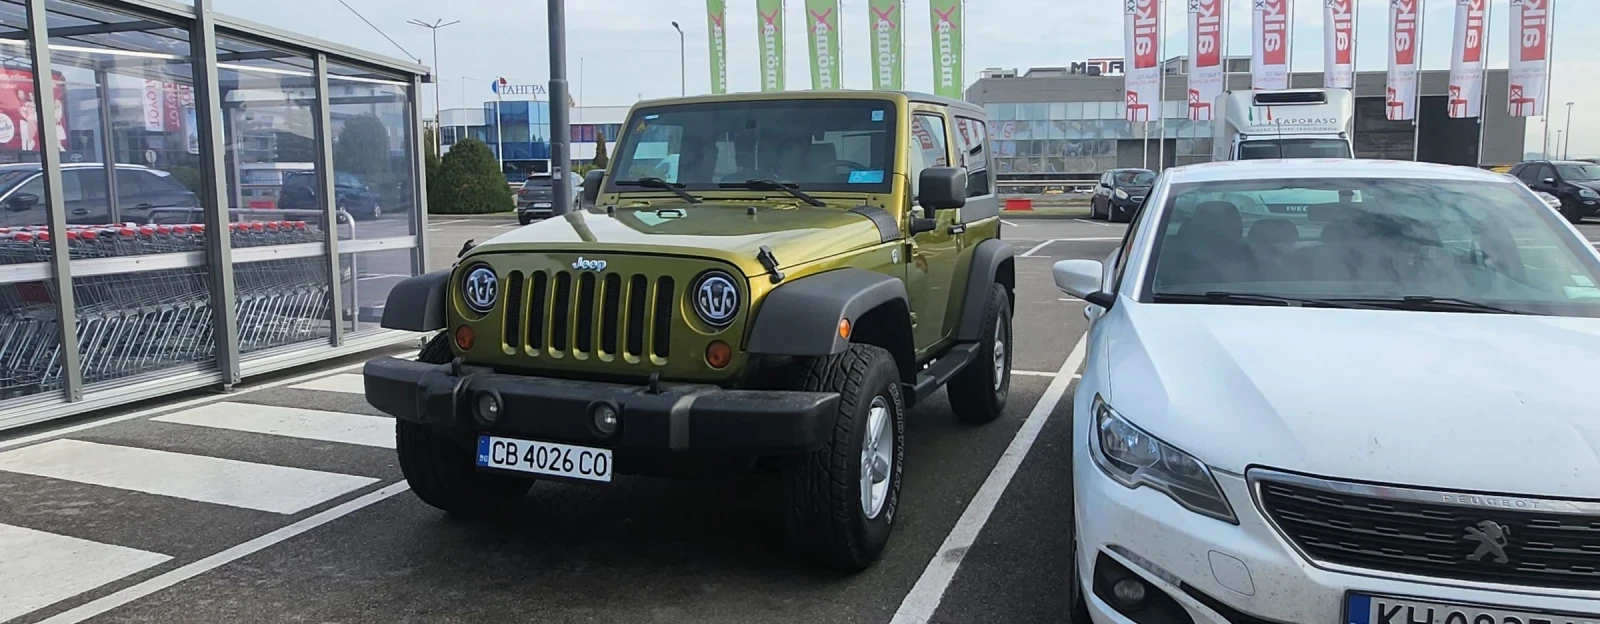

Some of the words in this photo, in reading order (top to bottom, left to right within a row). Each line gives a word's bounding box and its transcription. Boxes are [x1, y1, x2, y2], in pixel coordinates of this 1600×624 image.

[500, 84, 546, 95] ТАНГРА
[1275, 117, 1337, 125] CAPORASO
[571, 256, 607, 272] Jeep
[492, 441, 518, 466] CB
[523, 445, 574, 472] 4026
[579, 451, 607, 476] CO
[1442, 494, 1540, 509] PEUGEOT
